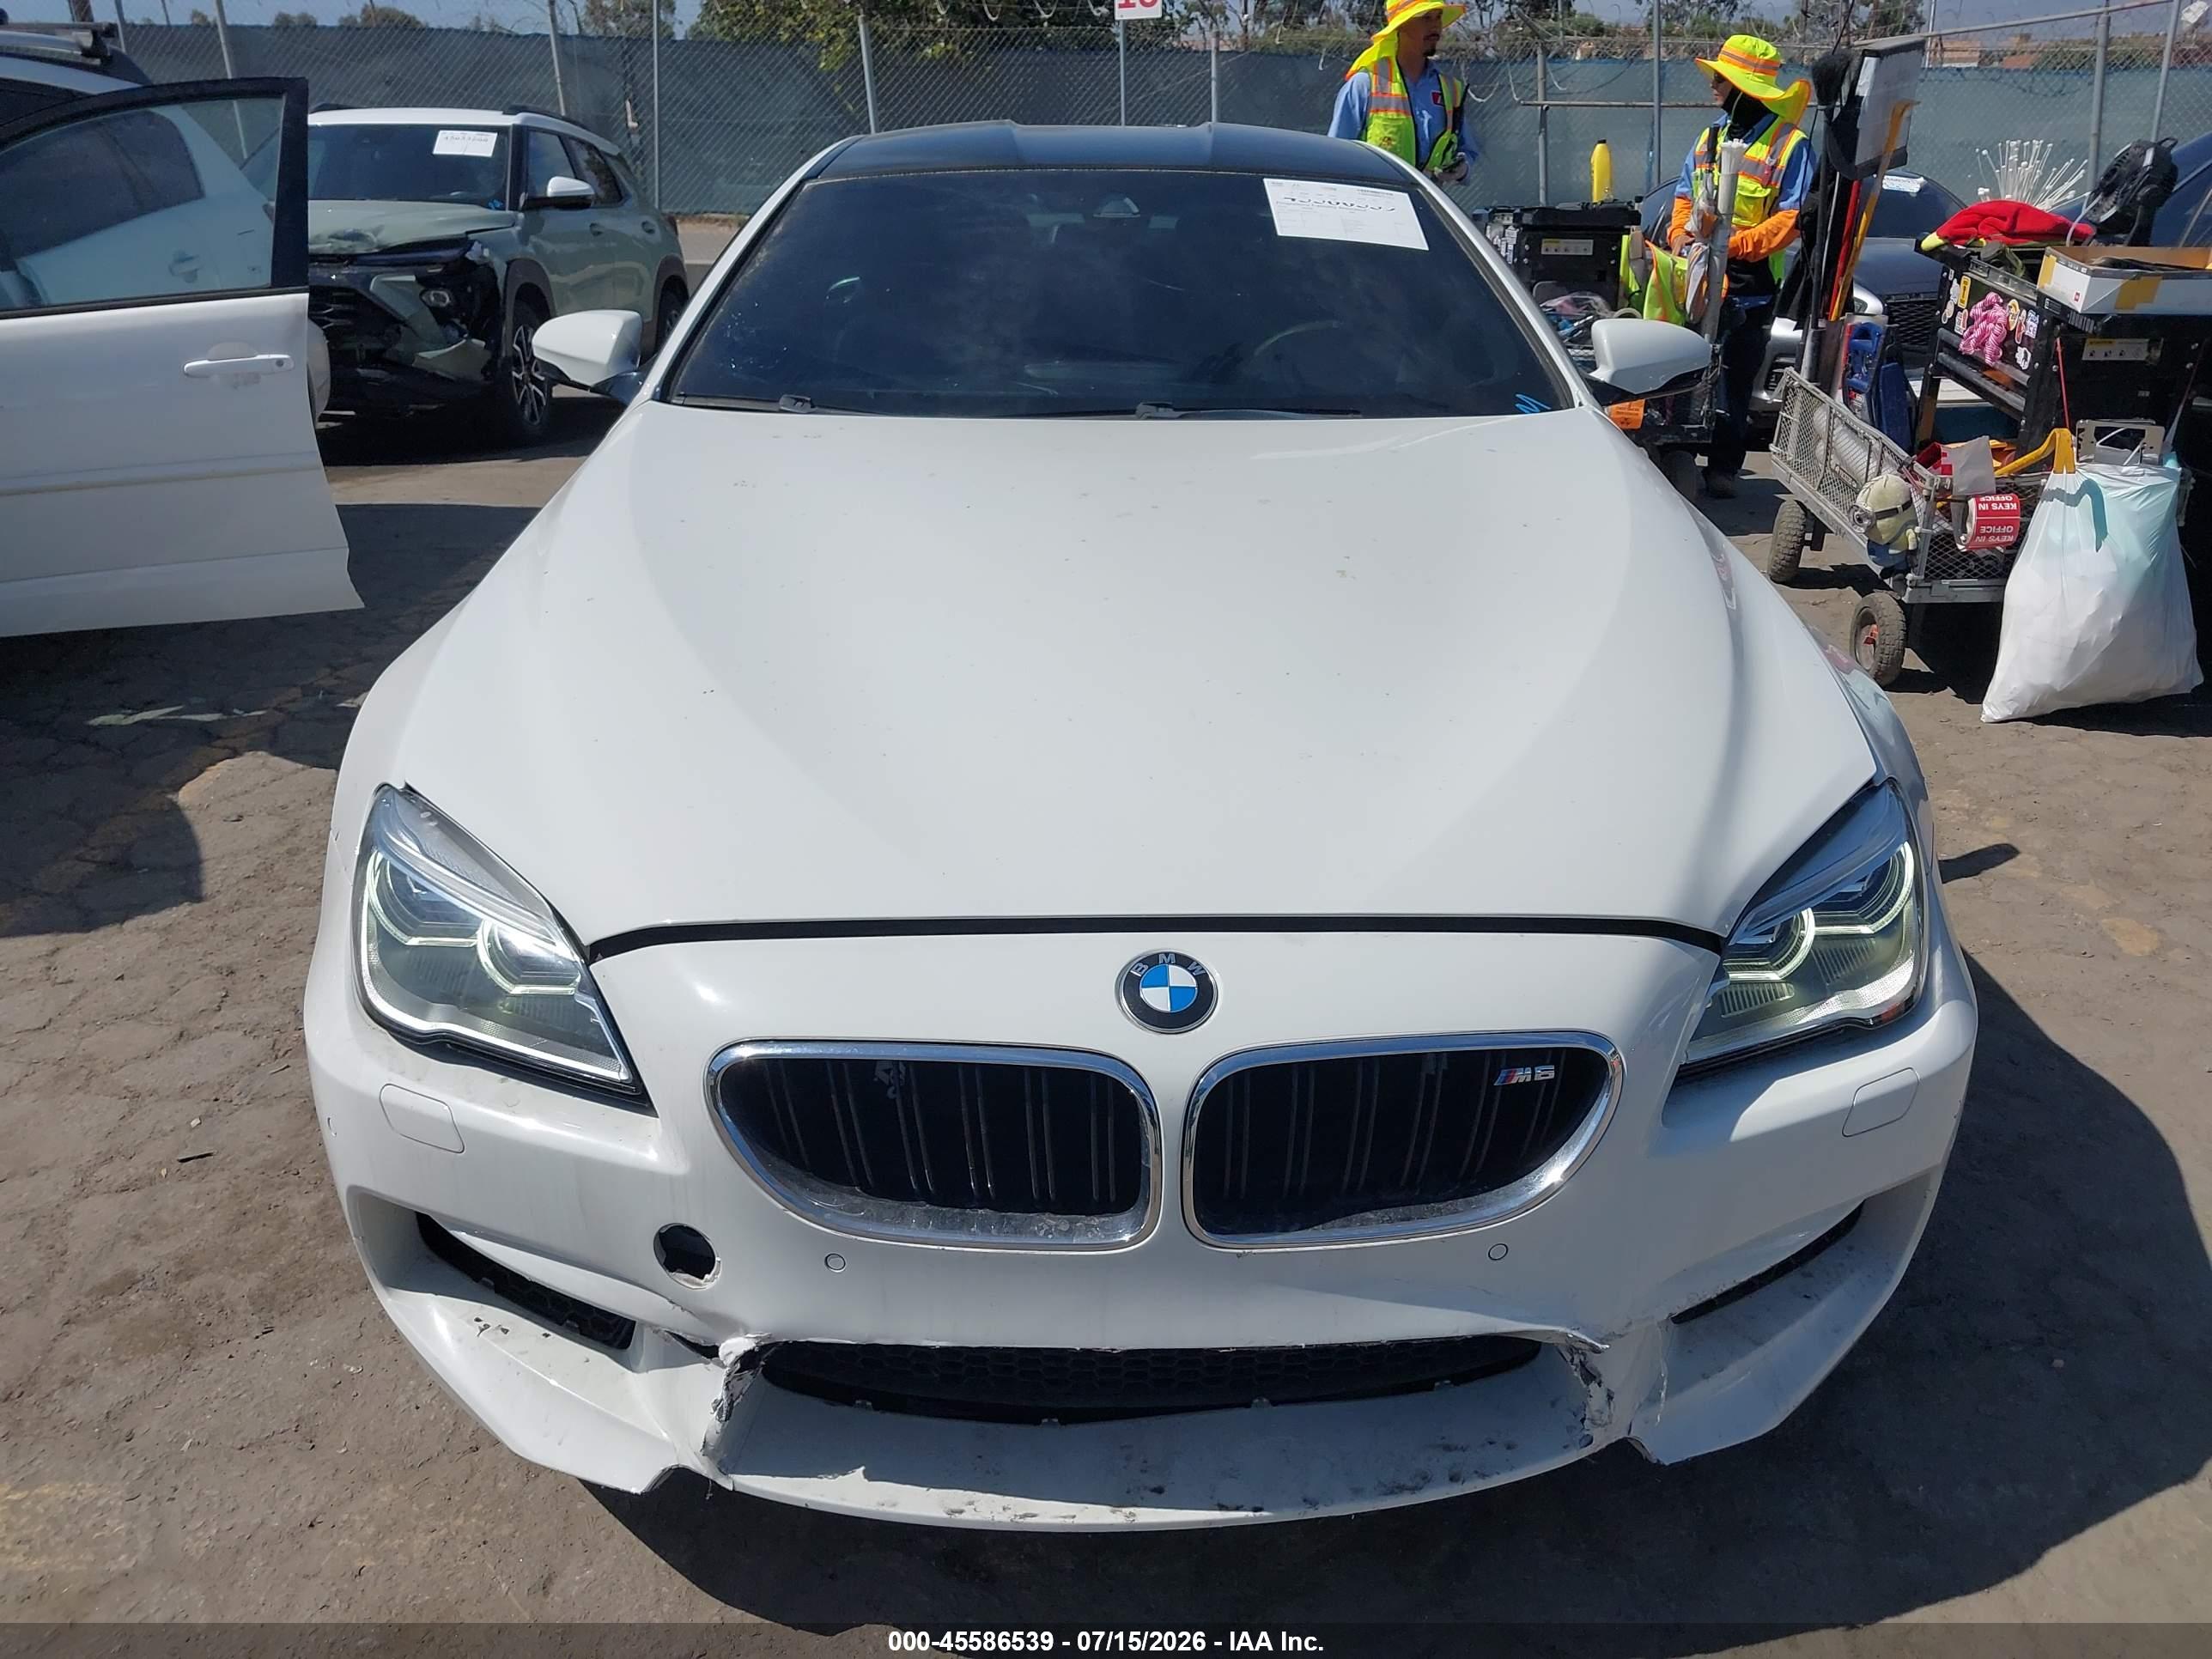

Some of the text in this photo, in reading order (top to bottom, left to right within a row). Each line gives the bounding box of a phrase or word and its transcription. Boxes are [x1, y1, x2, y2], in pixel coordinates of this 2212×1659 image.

[1990, 502, 2017, 511] KEYS
[1979, 526, 2014, 534] OFFICE
[1130, 953, 1206, 977] BMW
